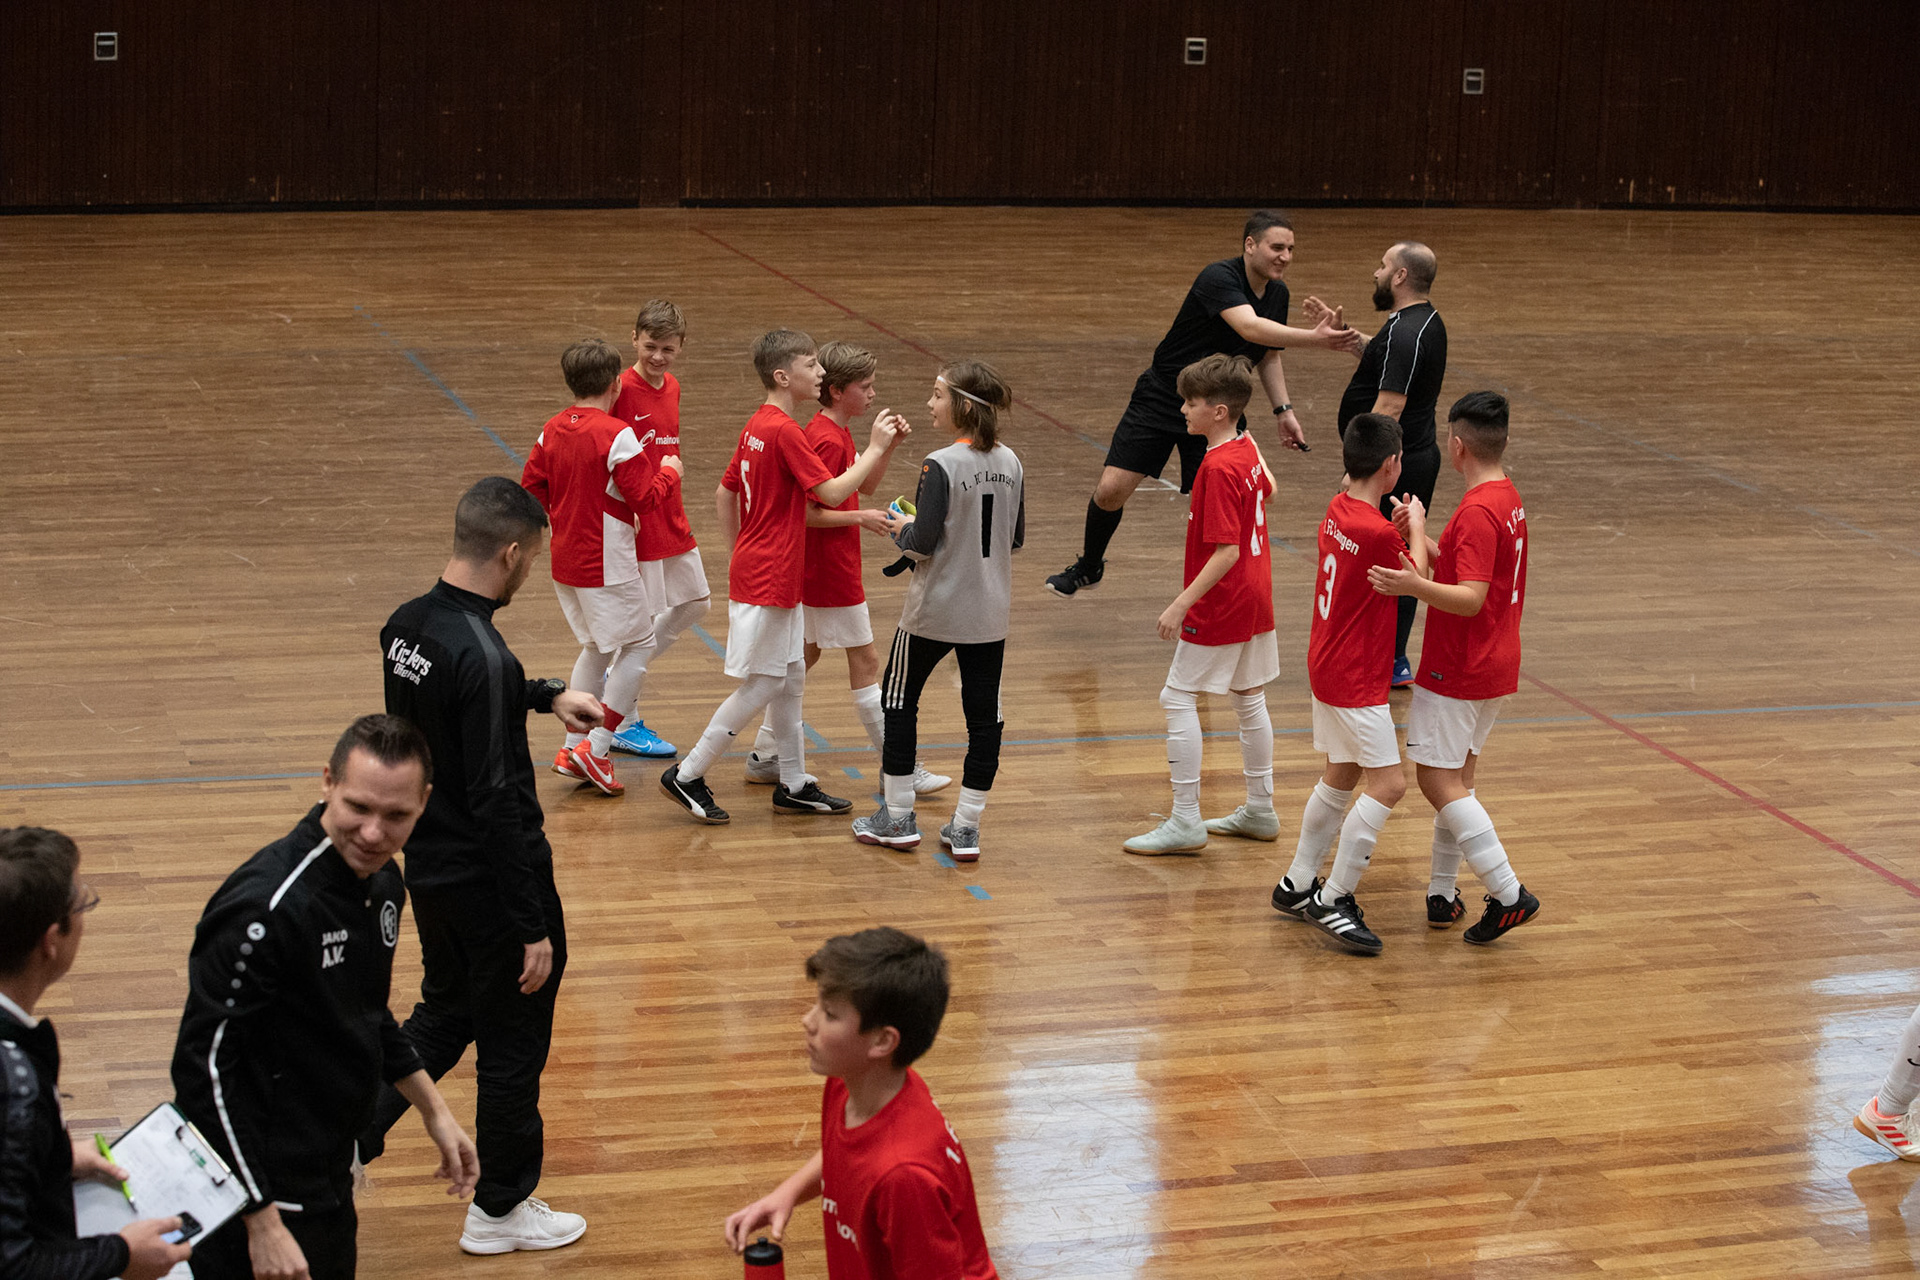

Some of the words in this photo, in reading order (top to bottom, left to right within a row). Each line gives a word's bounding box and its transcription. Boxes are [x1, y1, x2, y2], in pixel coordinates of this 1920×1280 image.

[960, 480, 972, 491] 1.
[981, 493, 994, 558] 1
[1318, 553, 1337, 620] 3
[322, 929, 349, 946] JAKO
